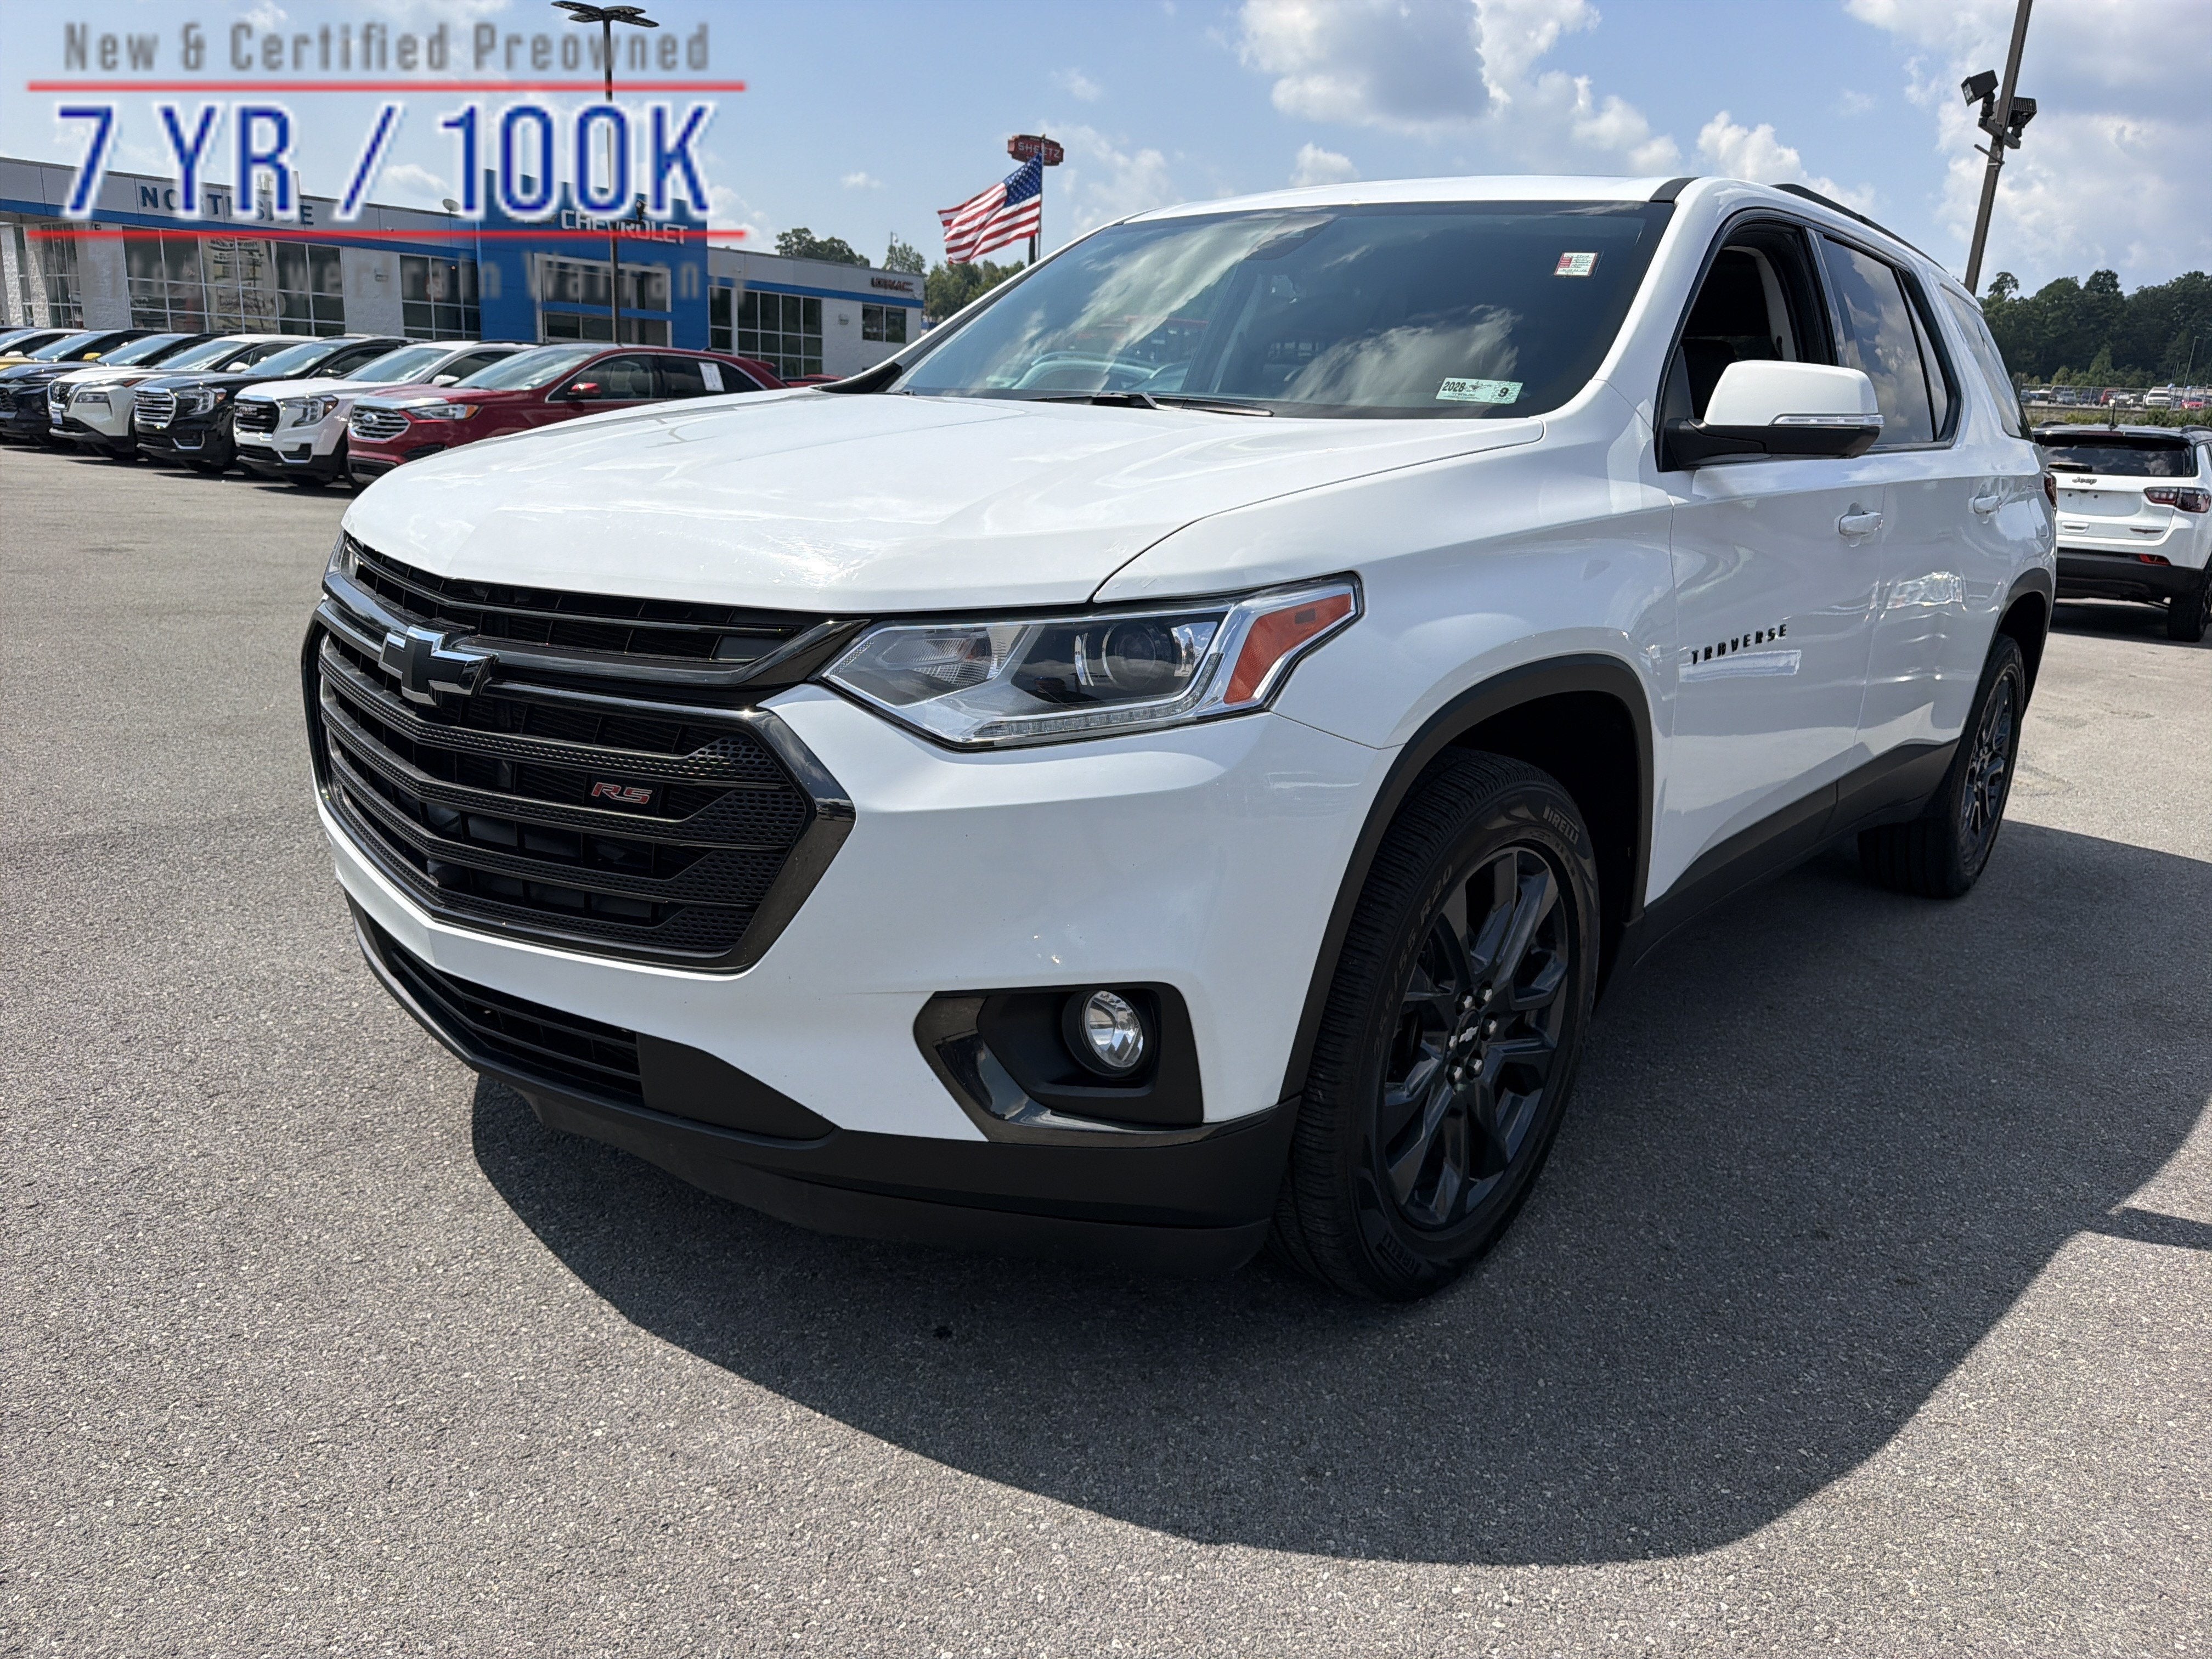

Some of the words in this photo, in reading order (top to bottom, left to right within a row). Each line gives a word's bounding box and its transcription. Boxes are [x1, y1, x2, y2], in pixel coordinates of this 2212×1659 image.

[1018, 142, 1061, 159] SHEETZ
[140, 185, 314, 225] NOTSIE
[561, 209, 689, 245] CHEVROLET
[1442, 381, 1466, 392] 2028
[1498, 387, 1509, 398] 9
[2072, 476, 2097, 486] Jeep
[1691, 624, 1787, 665] TRAVERSE
[591, 782, 653, 804] RS
[1543, 804, 1580, 846] PIRELLI
